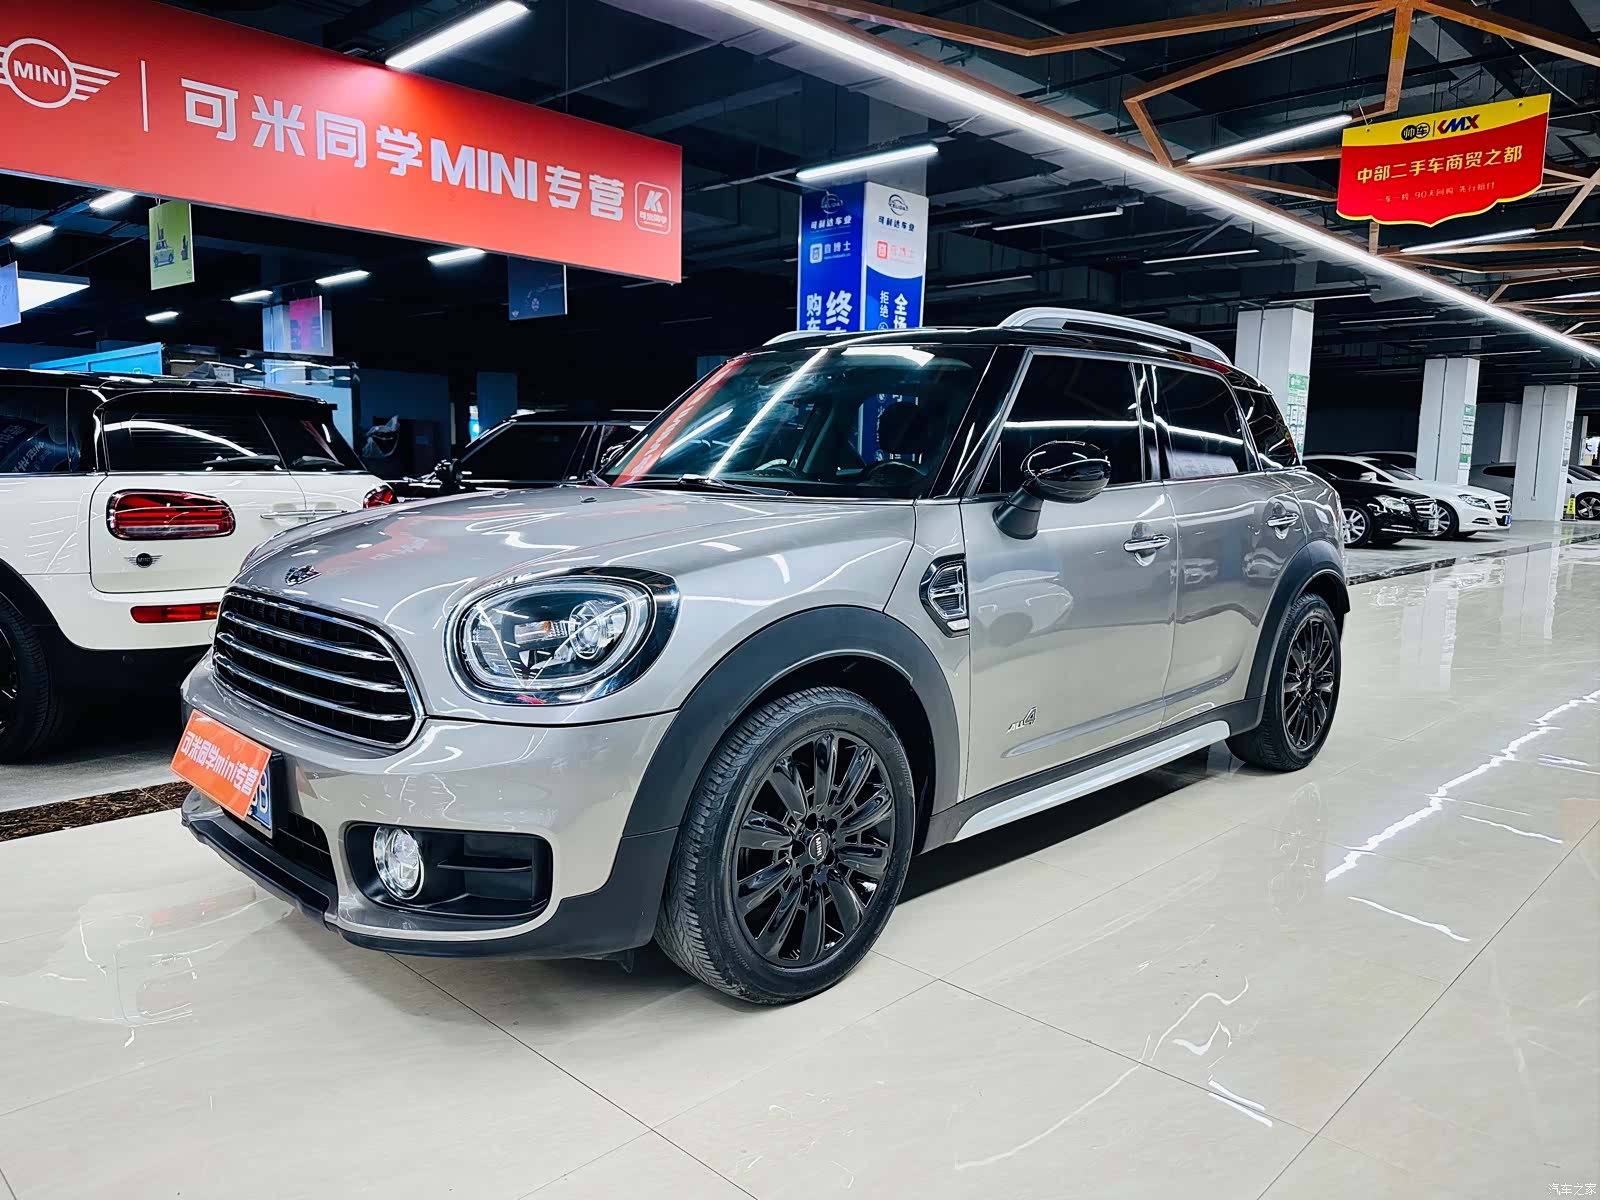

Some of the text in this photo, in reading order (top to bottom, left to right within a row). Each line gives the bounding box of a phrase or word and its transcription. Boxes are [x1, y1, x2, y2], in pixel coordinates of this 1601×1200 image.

[13, 60, 67, 87] MINI
[180, 78, 625, 222] 可米同学MINI专营
[1357, 145, 1523, 184] 中部二手车商贸之都
[825, 290, 853, 332] 终
[815, 836, 823, 857] MINI
